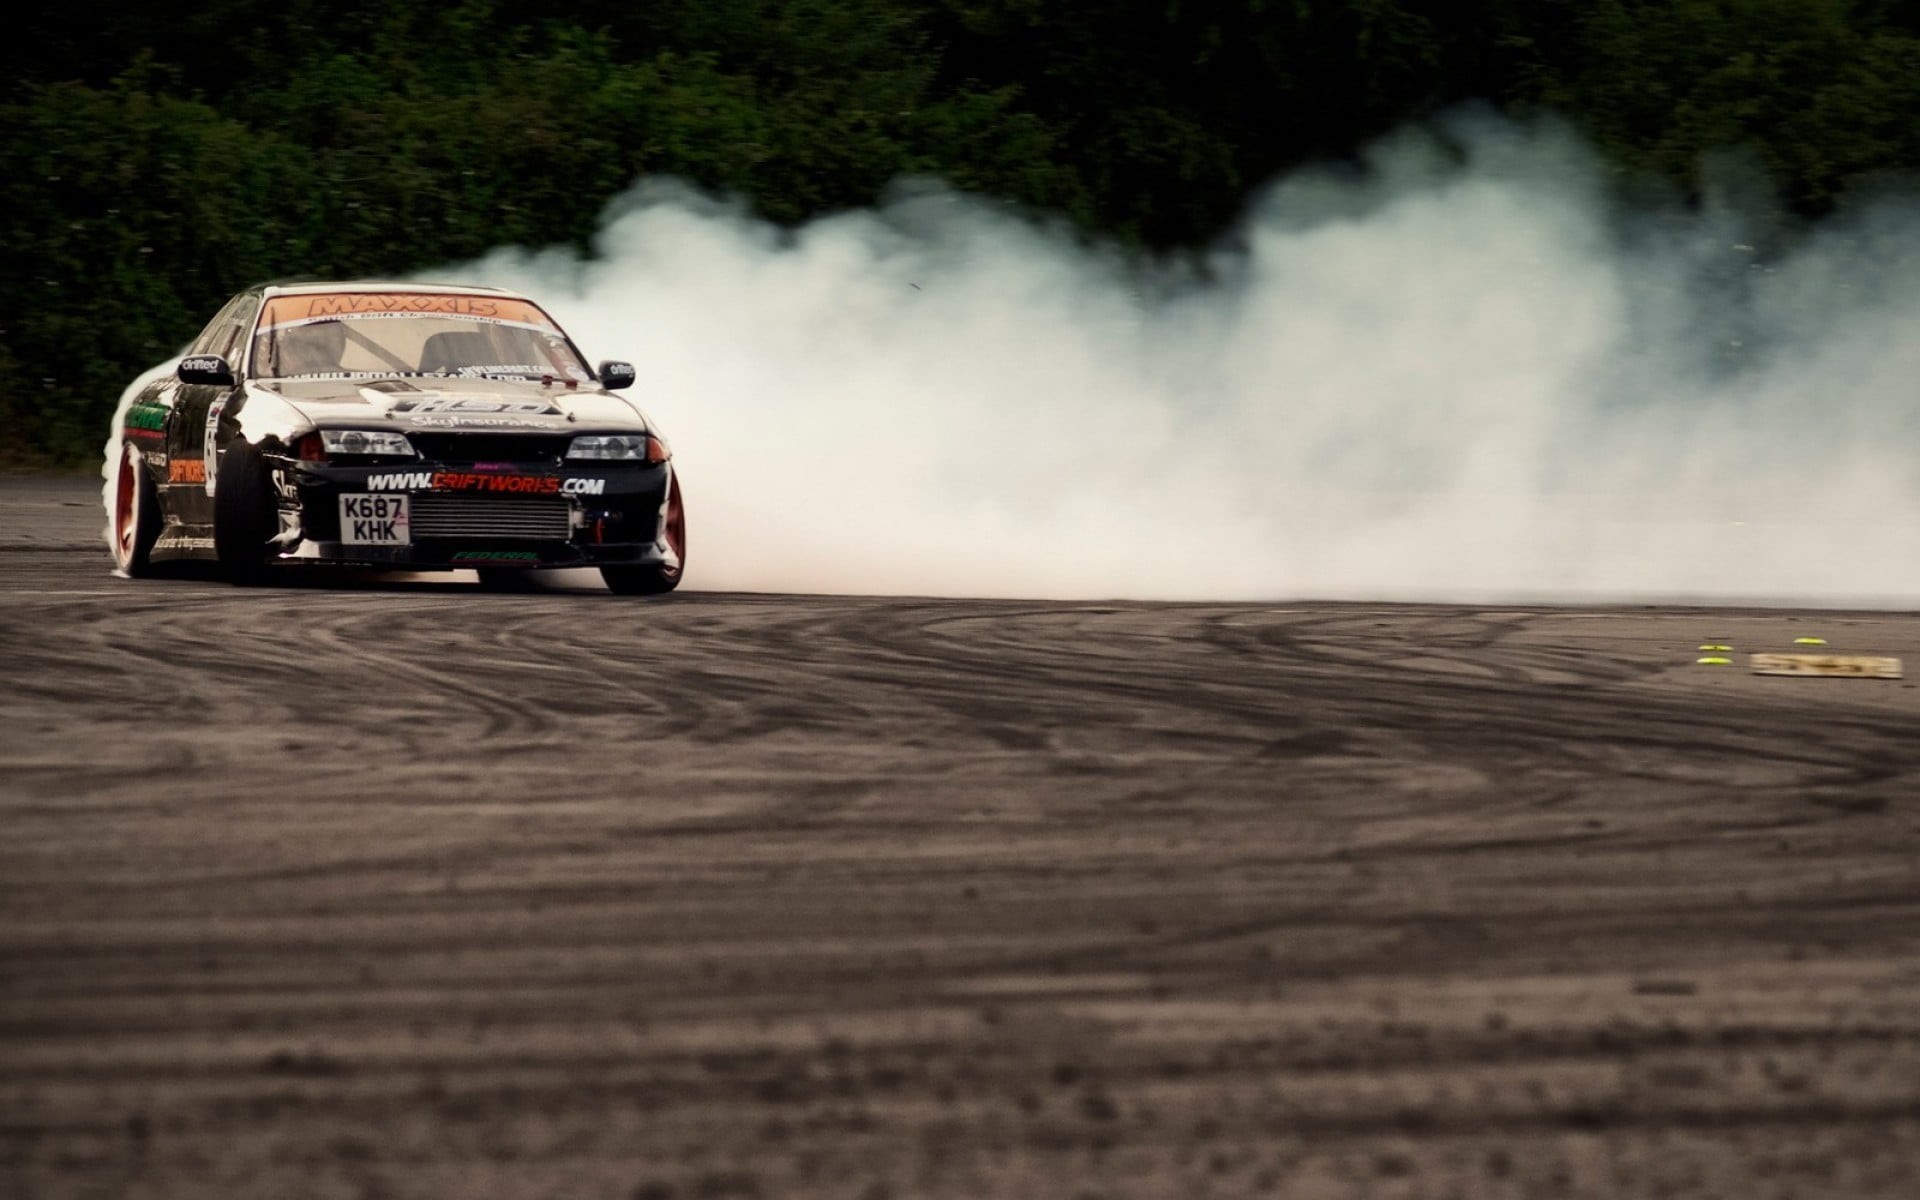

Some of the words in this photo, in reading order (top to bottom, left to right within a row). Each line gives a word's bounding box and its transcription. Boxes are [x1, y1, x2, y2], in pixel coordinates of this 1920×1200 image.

[307, 295, 498, 317] MAXXIS
[182, 360, 219, 371] drifted
[344, 497, 403, 519] K687
[353, 520, 397, 540] KHK
